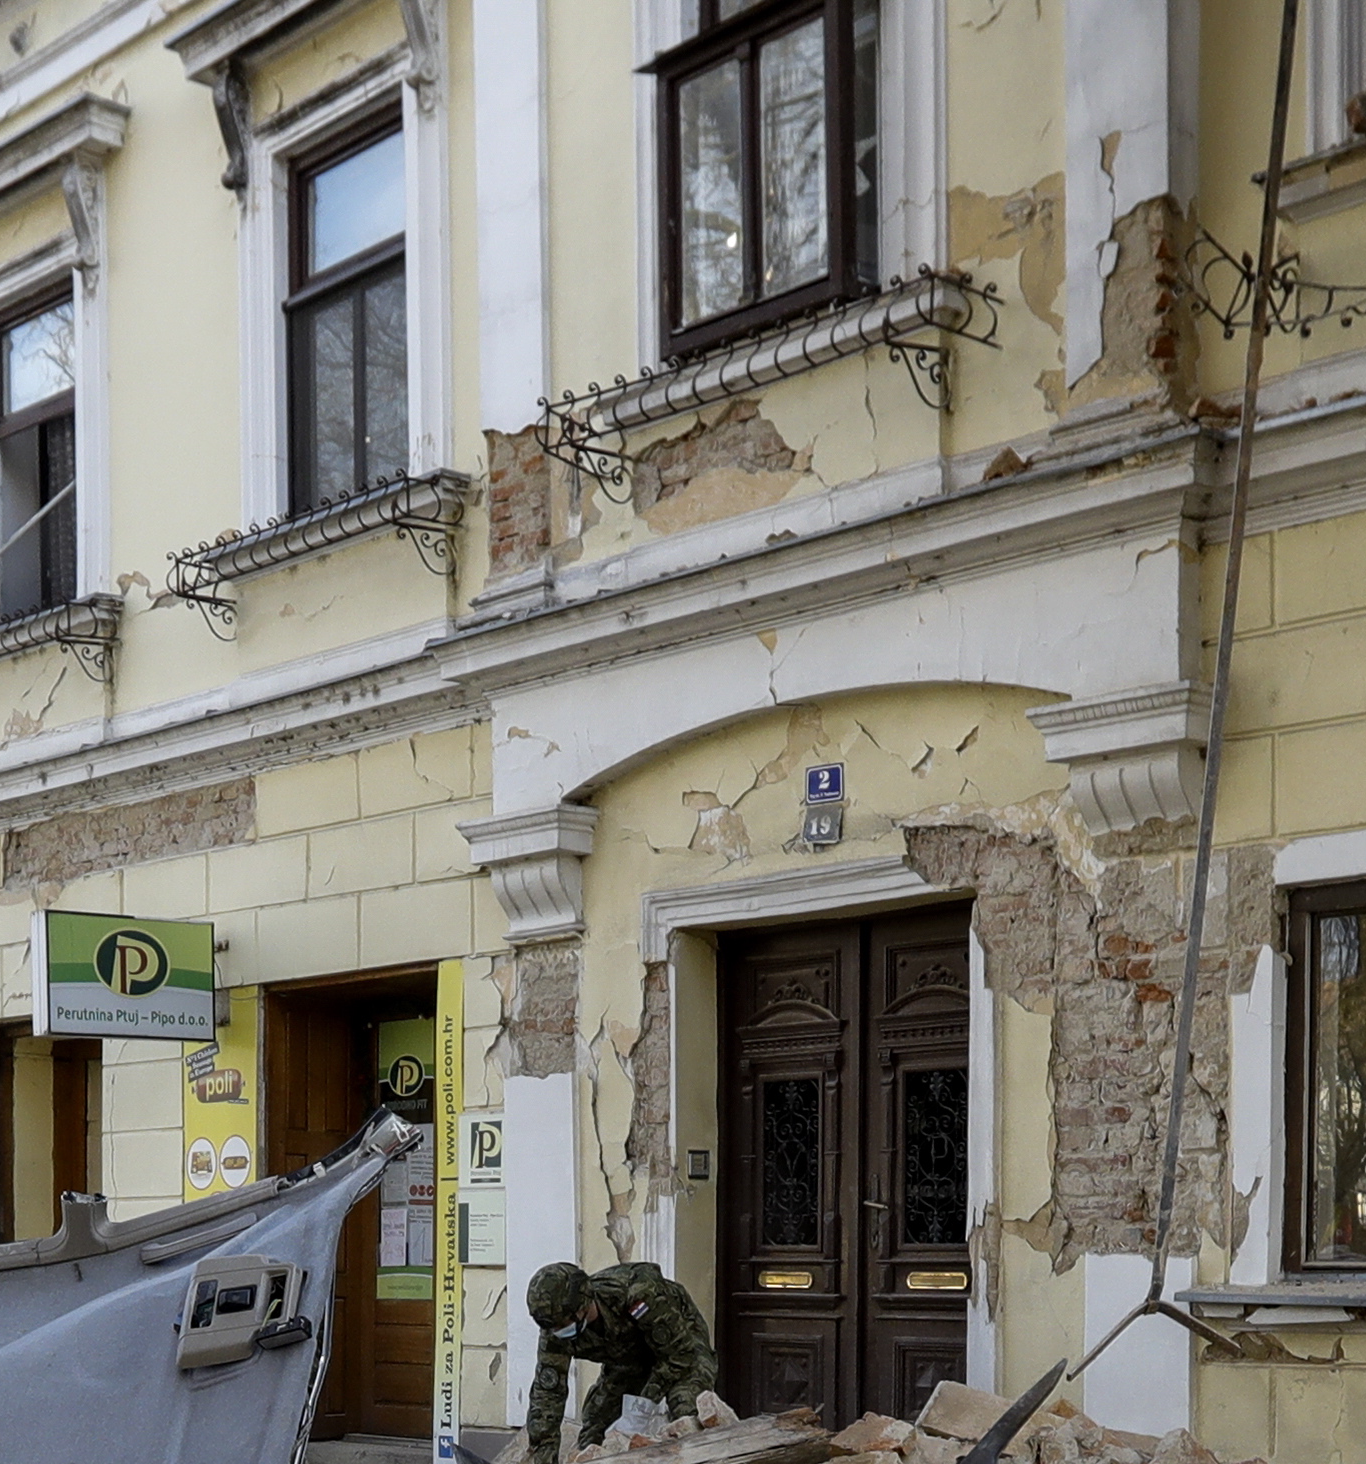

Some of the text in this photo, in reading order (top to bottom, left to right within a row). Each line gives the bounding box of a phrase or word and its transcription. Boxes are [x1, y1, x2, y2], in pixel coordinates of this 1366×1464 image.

[818, 770, 830, 789] 2
[810, 816, 831, 835] 19
[57, 1006, 113, 1022] Perutnina
[116, 1009, 139, 1026] Ptuj
[151, 1011, 176, 1027] Pipo
[178, 1012, 209, 1027] d.o.o.
[206, 1070, 233, 1101] poli
[443, 1014, 456, 1166] www.poli.com.hr
[442, 1192, 456, 1345] Poli-Hrvatska
[445, 1350, 454, 1374] za
[441, 1380, 453, 1429] Ludi
